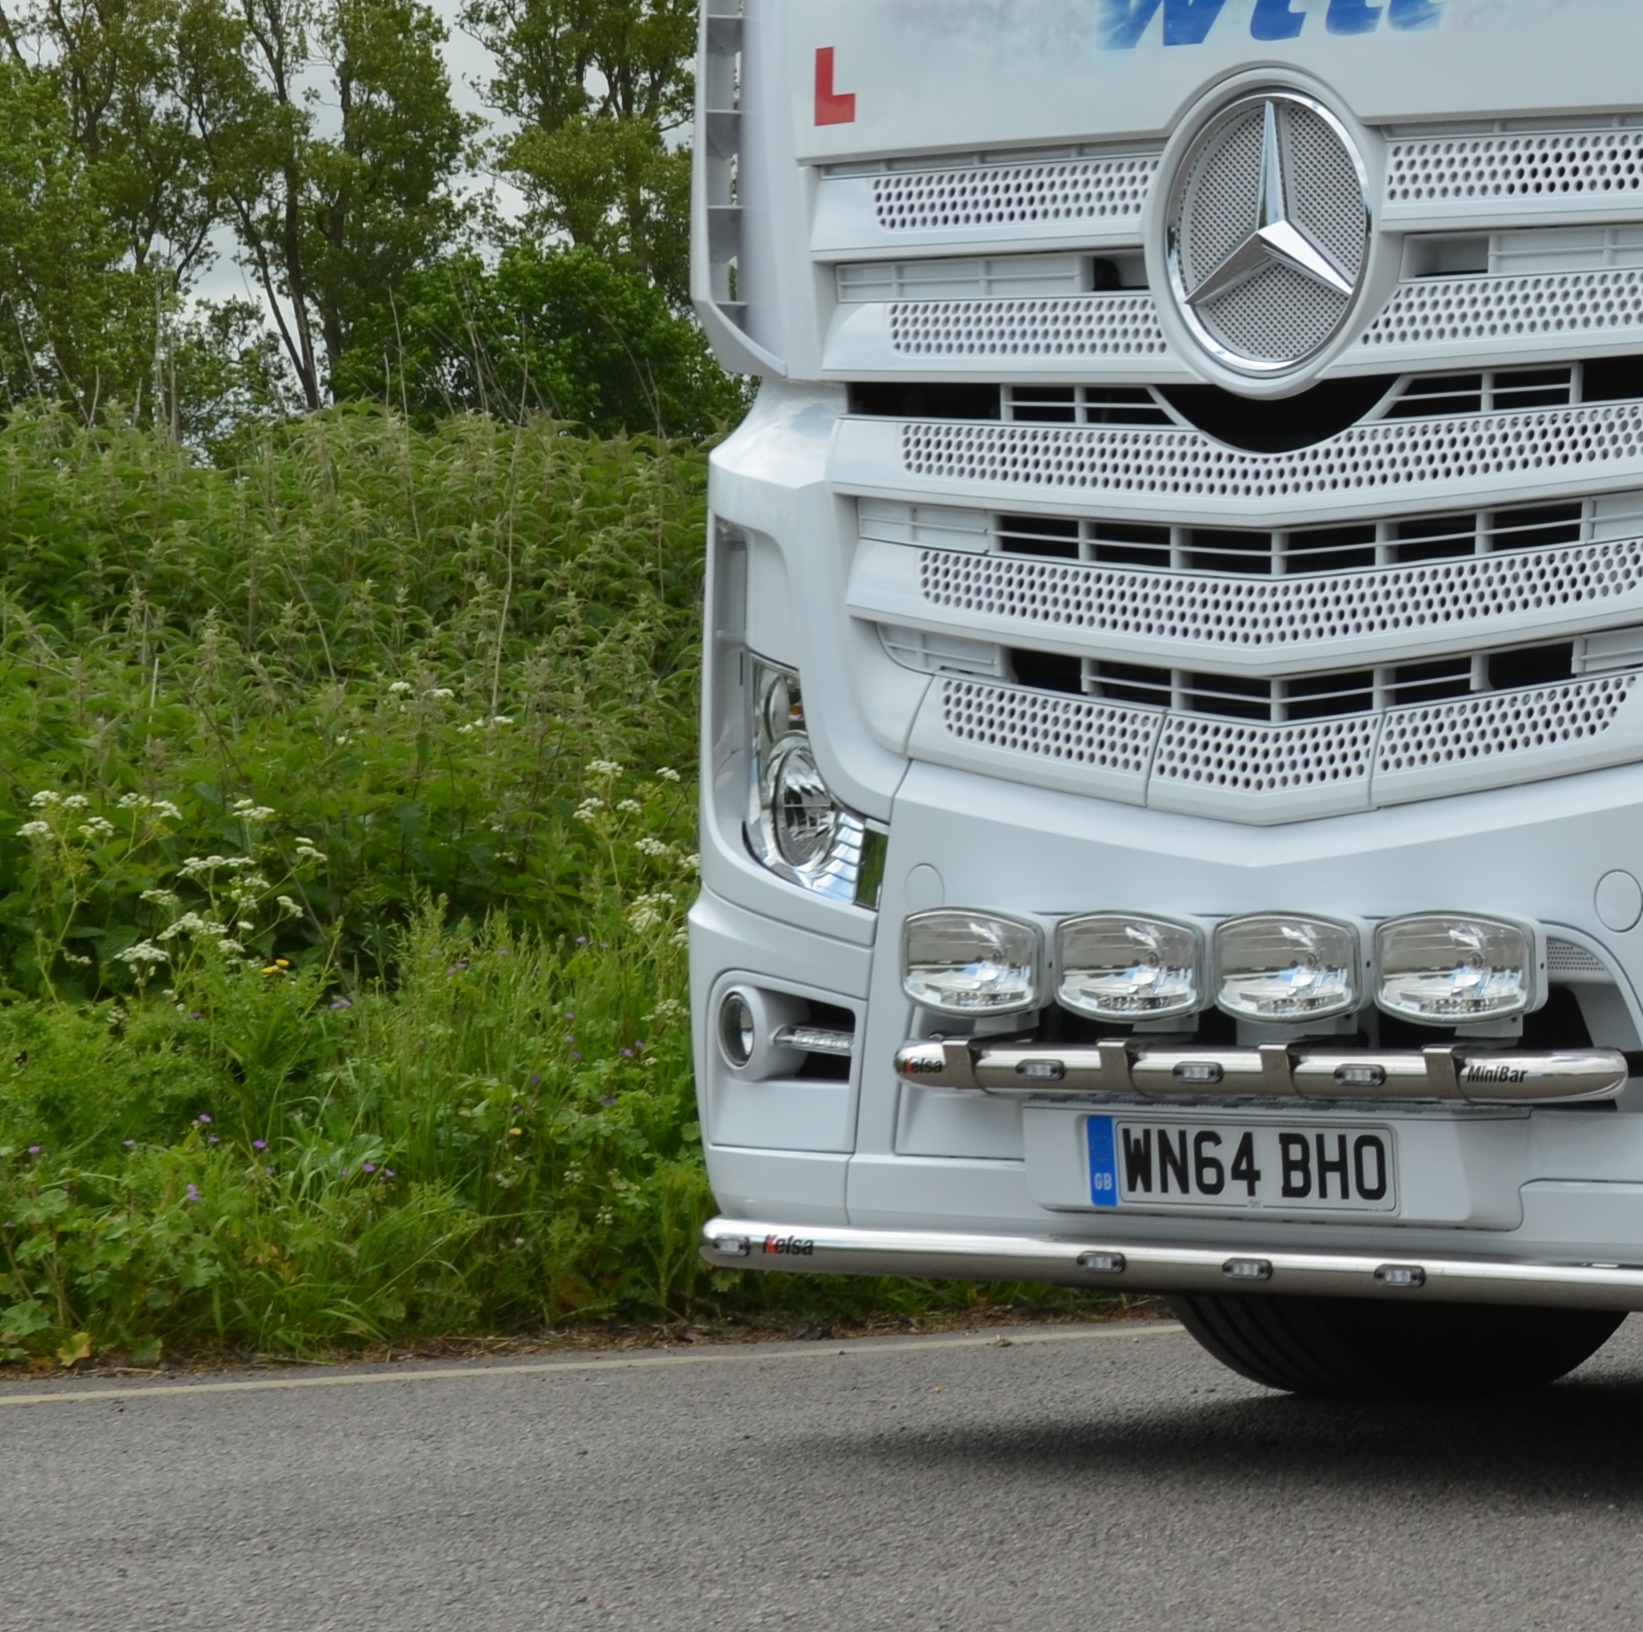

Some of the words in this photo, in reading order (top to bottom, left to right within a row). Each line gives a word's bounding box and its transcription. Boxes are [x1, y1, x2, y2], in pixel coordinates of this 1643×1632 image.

[814, 47, 855, 126] L
[1467, 1065, 1528, 1083] MiniBar
[1122, 1128, 1261, 1197] WN64
[1279, 1132, 1387, 1201] BHO
[1094, 1173, 1112, 1190] GB
[763, 1234, 814, 1256] Kelsa
